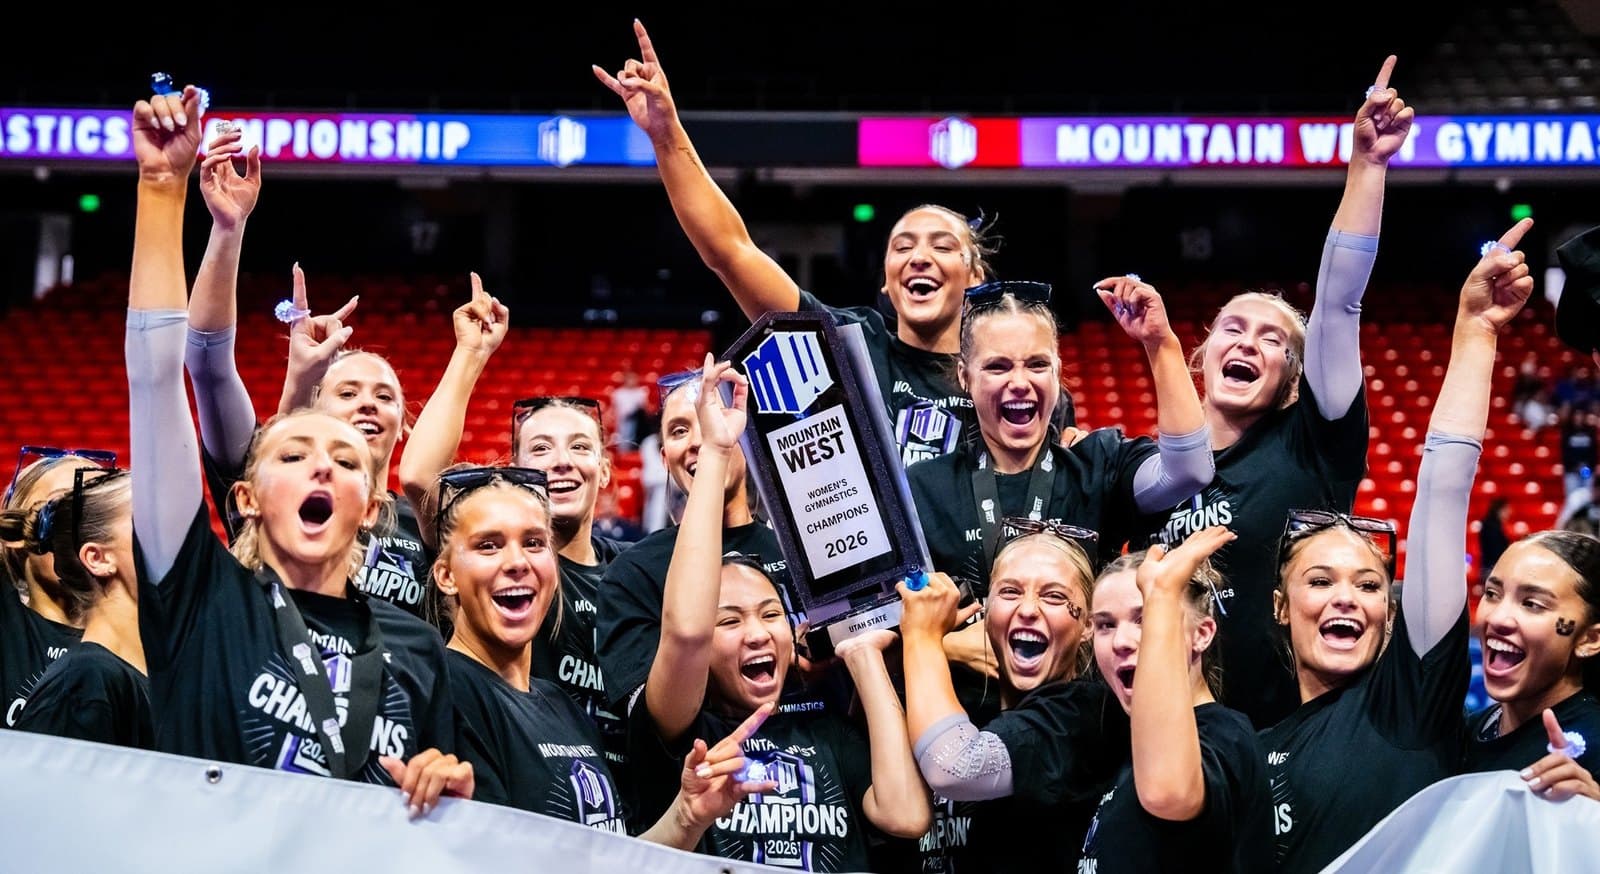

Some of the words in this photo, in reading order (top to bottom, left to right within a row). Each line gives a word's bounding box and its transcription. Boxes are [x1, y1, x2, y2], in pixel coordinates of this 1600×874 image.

[0, 114, 130, 154] STICS
[200, 118, 471, 160] AMPIONSHIP
[1056, 123, 1284, 163] MOUNTAIN
[1299, 122, 1421, 163] WT
[1436, 122, 1600, 162] GYMNA
[948, 396, 974, 408] WES
[777, 416, 841, 451] MOUNTAIN
[782, 430, 845, 473] WEST
[804, 486, 858, 513] GYMNASTICS
[807, 478, 848, 500] WOMEN'S
[806, 503, 869, 534] CHAMPIONS
[393, 537, 420, 552] WEST
[824, 530, 868, 559] 2026
[848, 620, 867, 633] UTAH
[867, 613, 888, 627] STATE
[248, 672, 408, 760] CHANS
[778, 701, 825, 713] YMNASTICS
[767, 839, 798, 855] 2026
